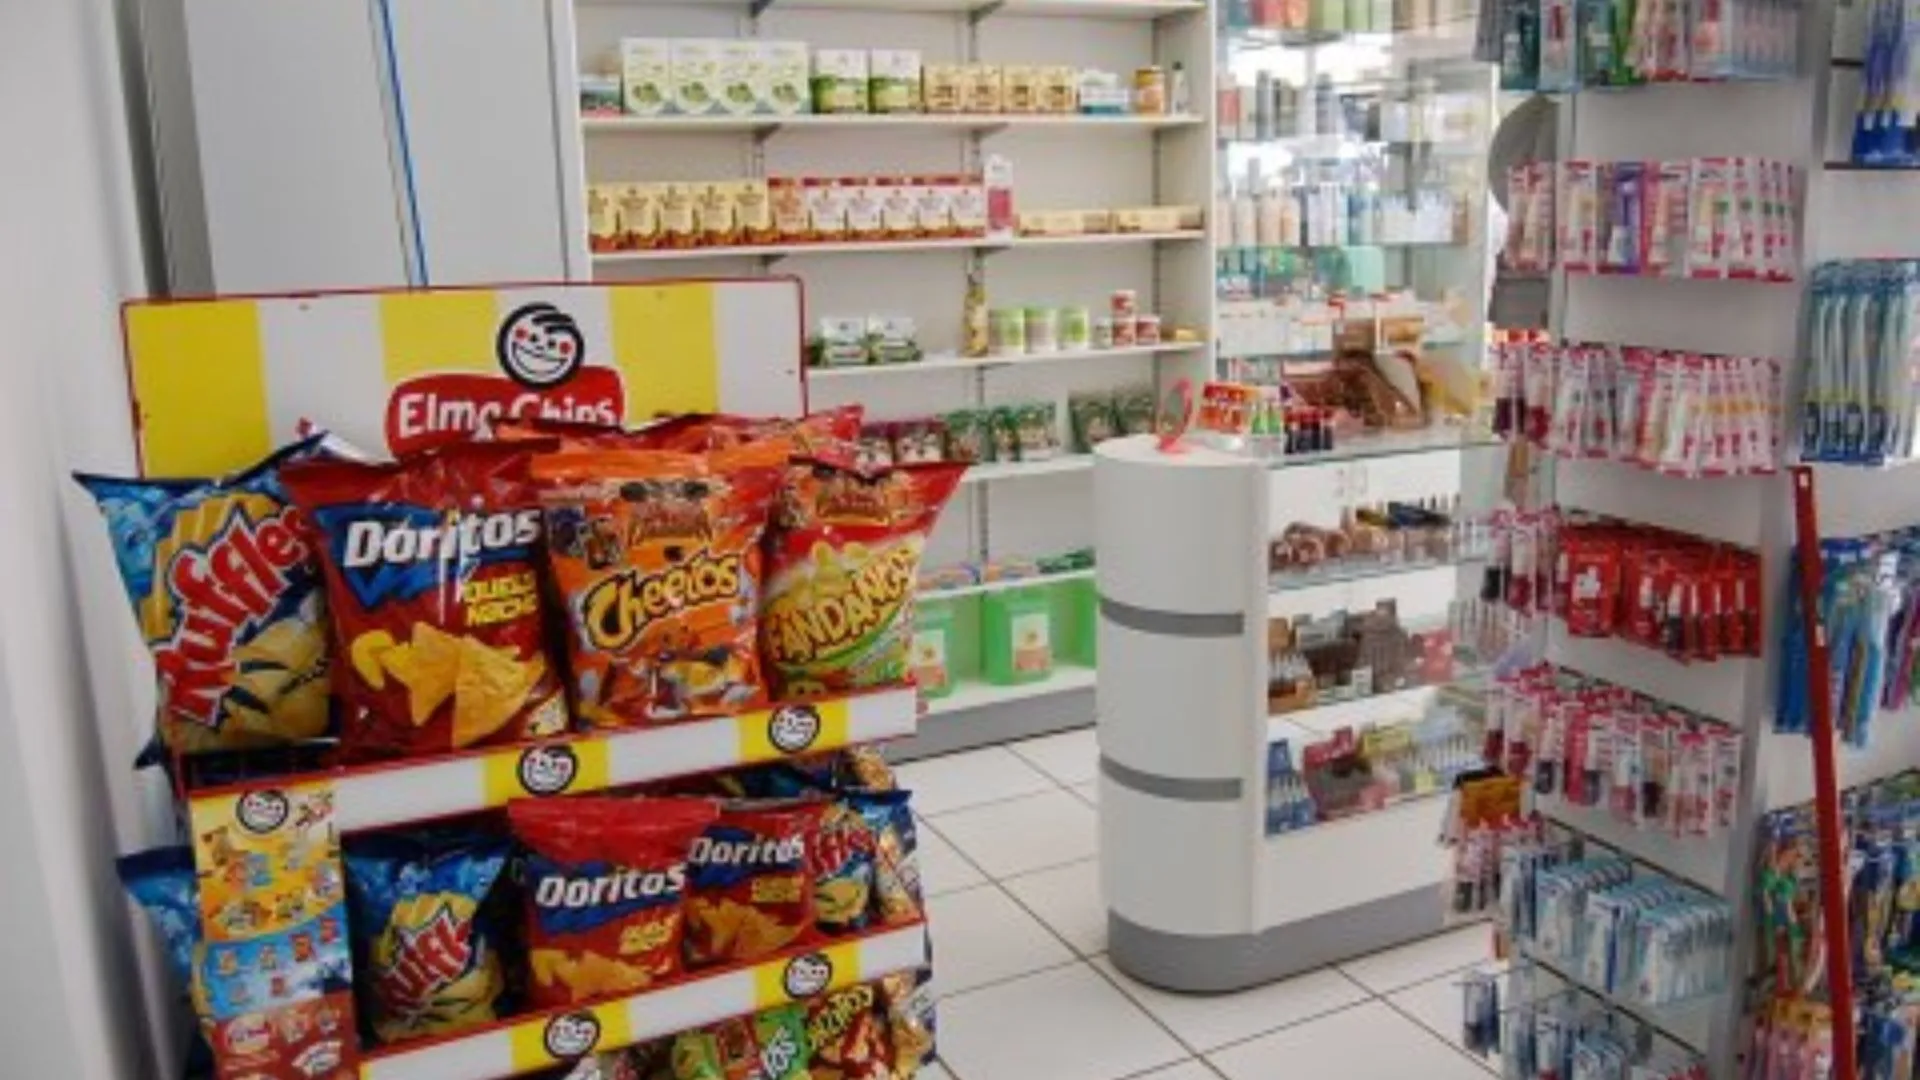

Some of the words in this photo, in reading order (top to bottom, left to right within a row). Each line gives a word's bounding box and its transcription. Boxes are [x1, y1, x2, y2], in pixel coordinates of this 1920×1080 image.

[343, 509, 541, 568] Doritos
[155, 505, 312, 728] Ruffles
[586, 552, 739, 650] Cheetos
[688, 833, 804, 863] Doritos
[535, 864, 686, 907] Doritos
